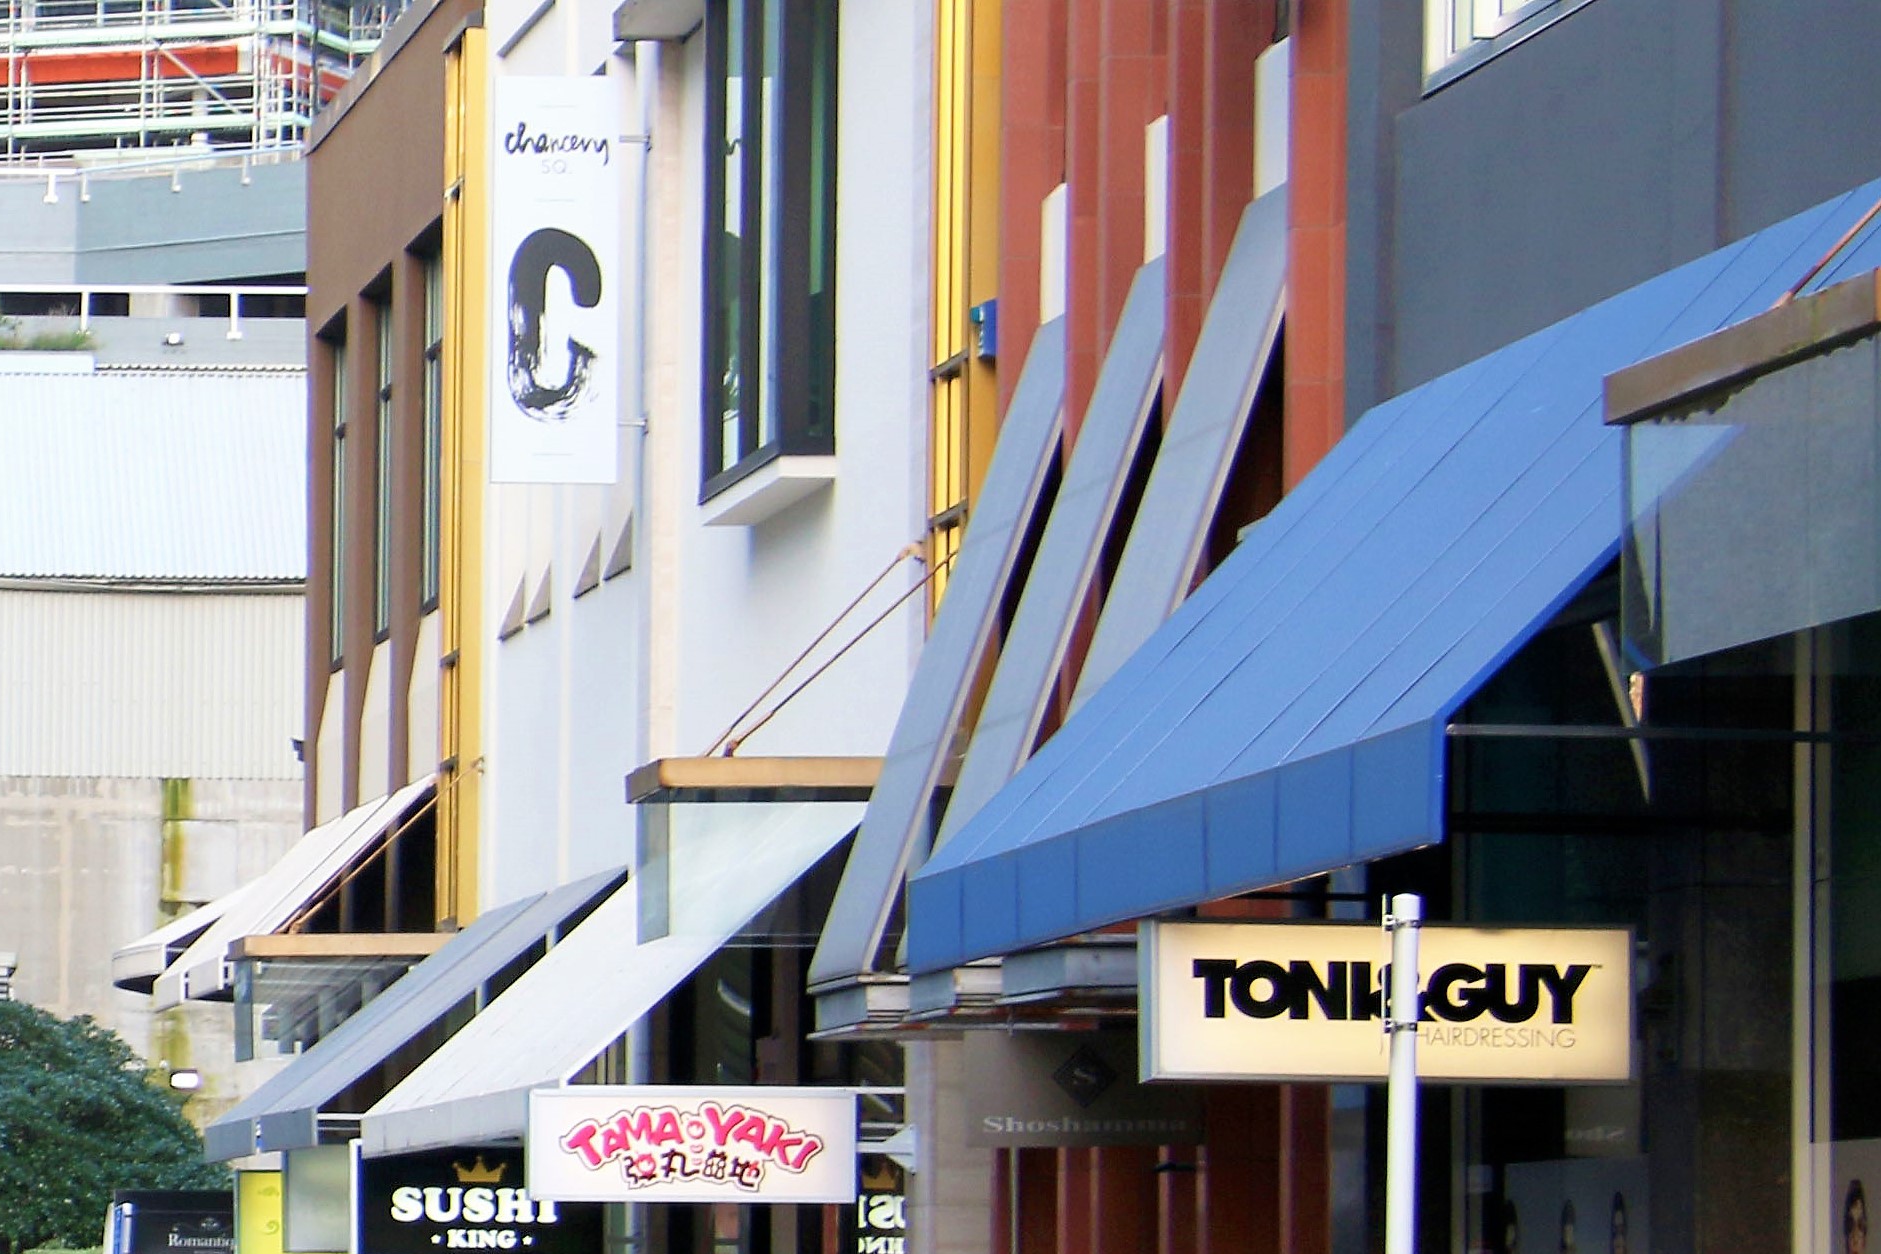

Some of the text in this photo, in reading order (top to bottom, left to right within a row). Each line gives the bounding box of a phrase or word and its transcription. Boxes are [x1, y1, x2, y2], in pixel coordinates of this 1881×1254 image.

[1414, 1026, 1577, 1049] HAIRDRESSING
[390, 1186, 558, 1223] SUSHI
[447, 1229, 518, 1249] KING
